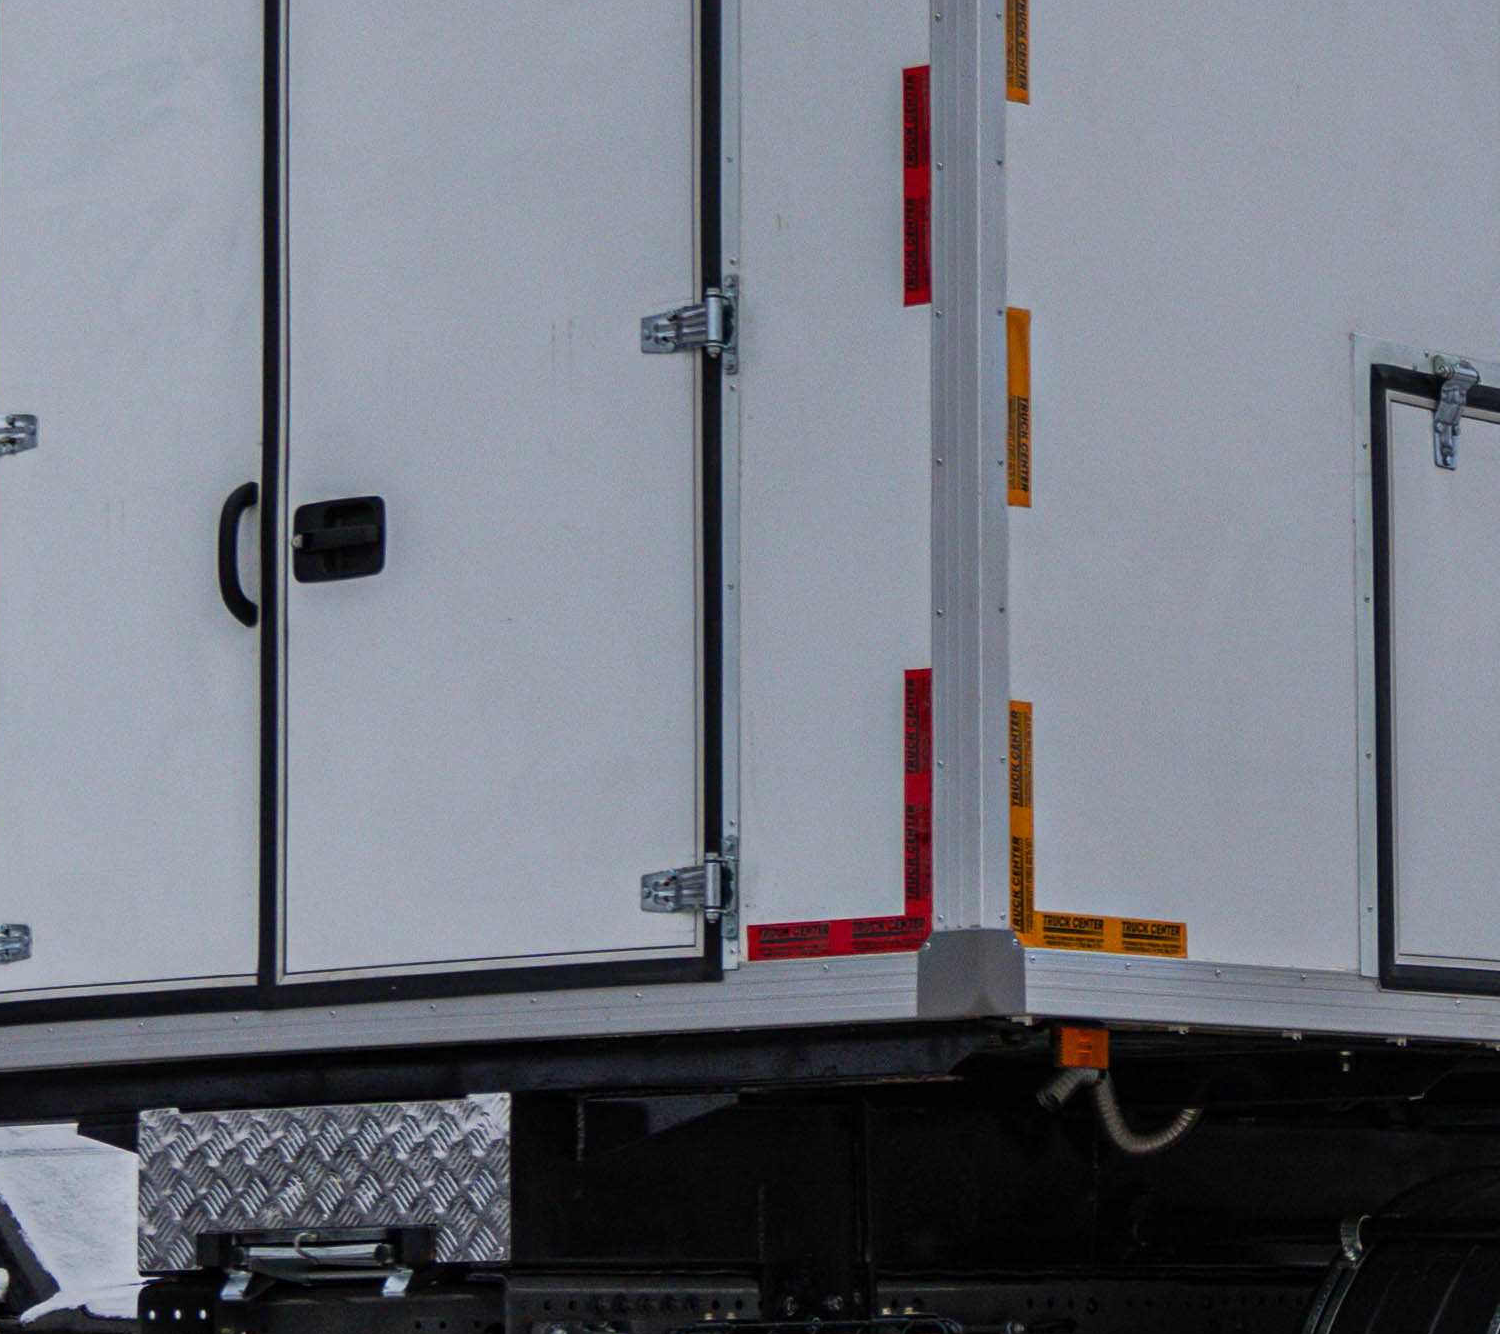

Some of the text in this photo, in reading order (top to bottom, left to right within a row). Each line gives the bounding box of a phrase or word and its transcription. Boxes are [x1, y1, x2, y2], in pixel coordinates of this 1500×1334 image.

[1043, 914, 1104, 931] TRUCK CENTER
[1121, 920, 1181, 937] TRUCK CENTER
